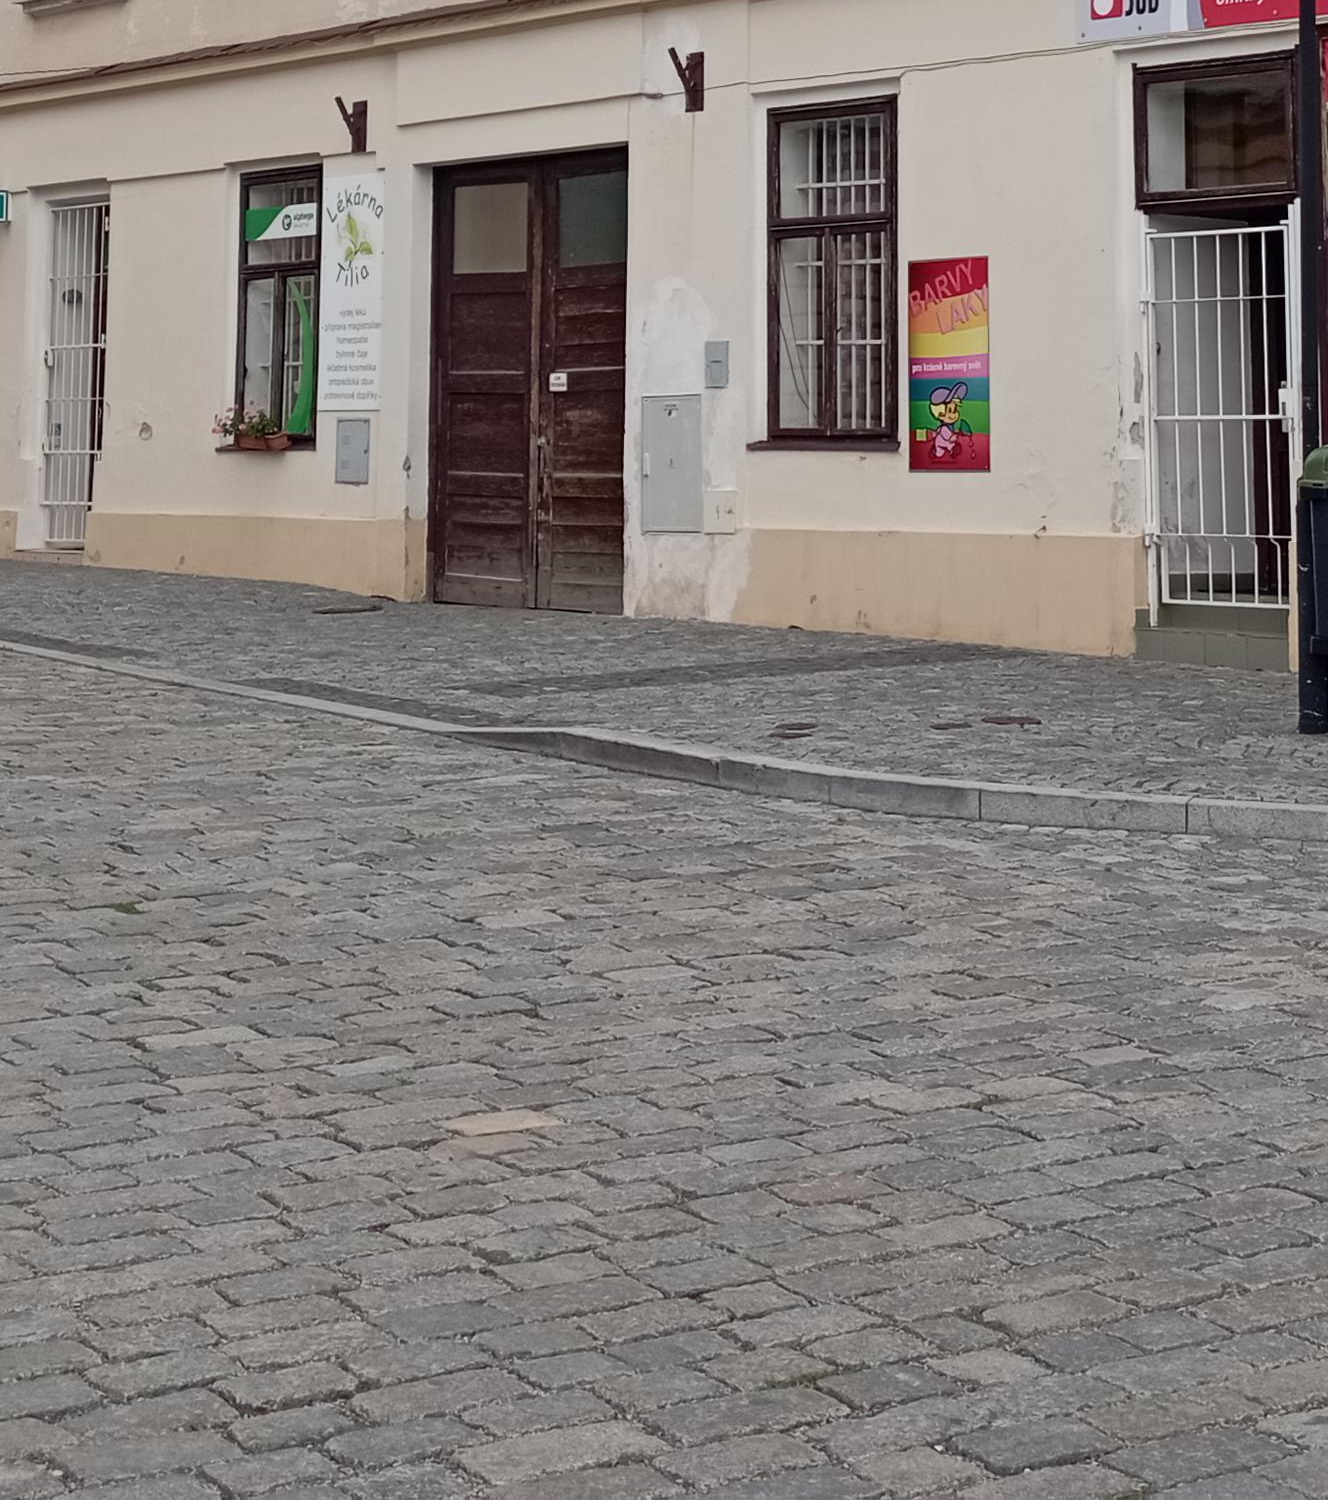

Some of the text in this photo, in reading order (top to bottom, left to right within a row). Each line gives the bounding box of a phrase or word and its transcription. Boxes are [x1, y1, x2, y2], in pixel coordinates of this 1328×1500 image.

[326, 184, 384, 223] Lékárna
[909, 259, 973, 318] BARVY
[936, 283, 988, 335] LAKY
